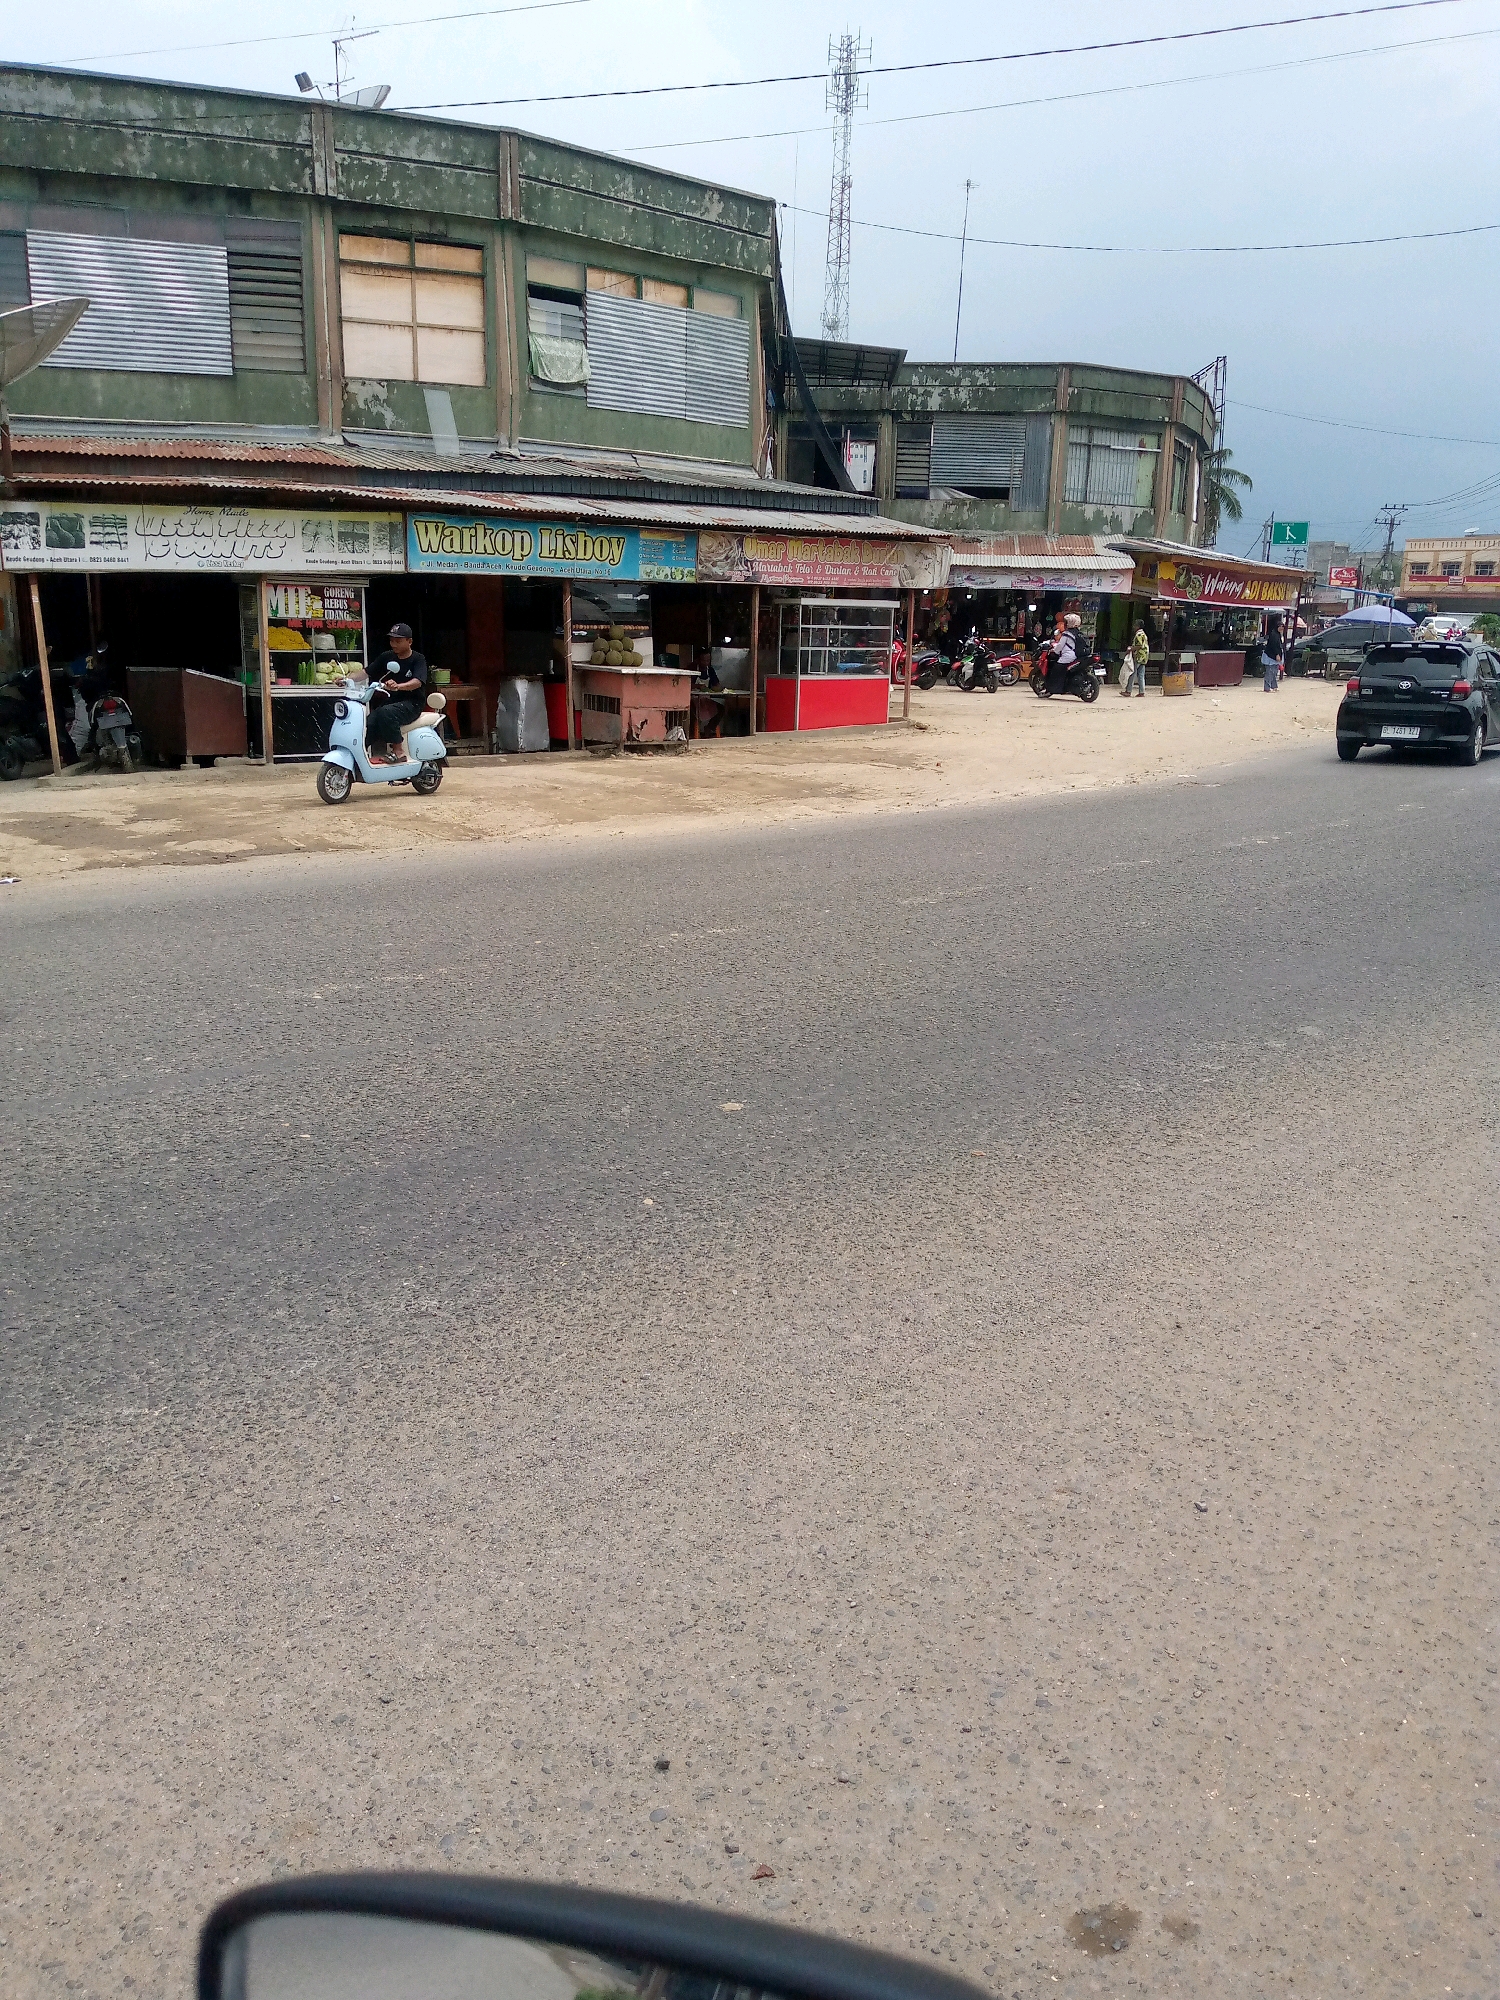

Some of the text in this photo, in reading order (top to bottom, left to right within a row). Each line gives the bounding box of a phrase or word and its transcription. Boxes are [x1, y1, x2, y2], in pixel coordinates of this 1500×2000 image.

[183, 505, 214, 515] Home
[414, 520, 625, 566] Warkop Lisboy
[743, 537, 786, 561] Umar
[787, 538, 860, 565] Martabak
[752, 562, 793, 573] Martabak
[825, 565, 851, 575] Durian
[1205, 571, 1244, 599] Warung
[266, 584, 354, 618] MIE GORENG
[325, 598, 348, 610] REBUS
[325, 609, 350, 620] UDANG
